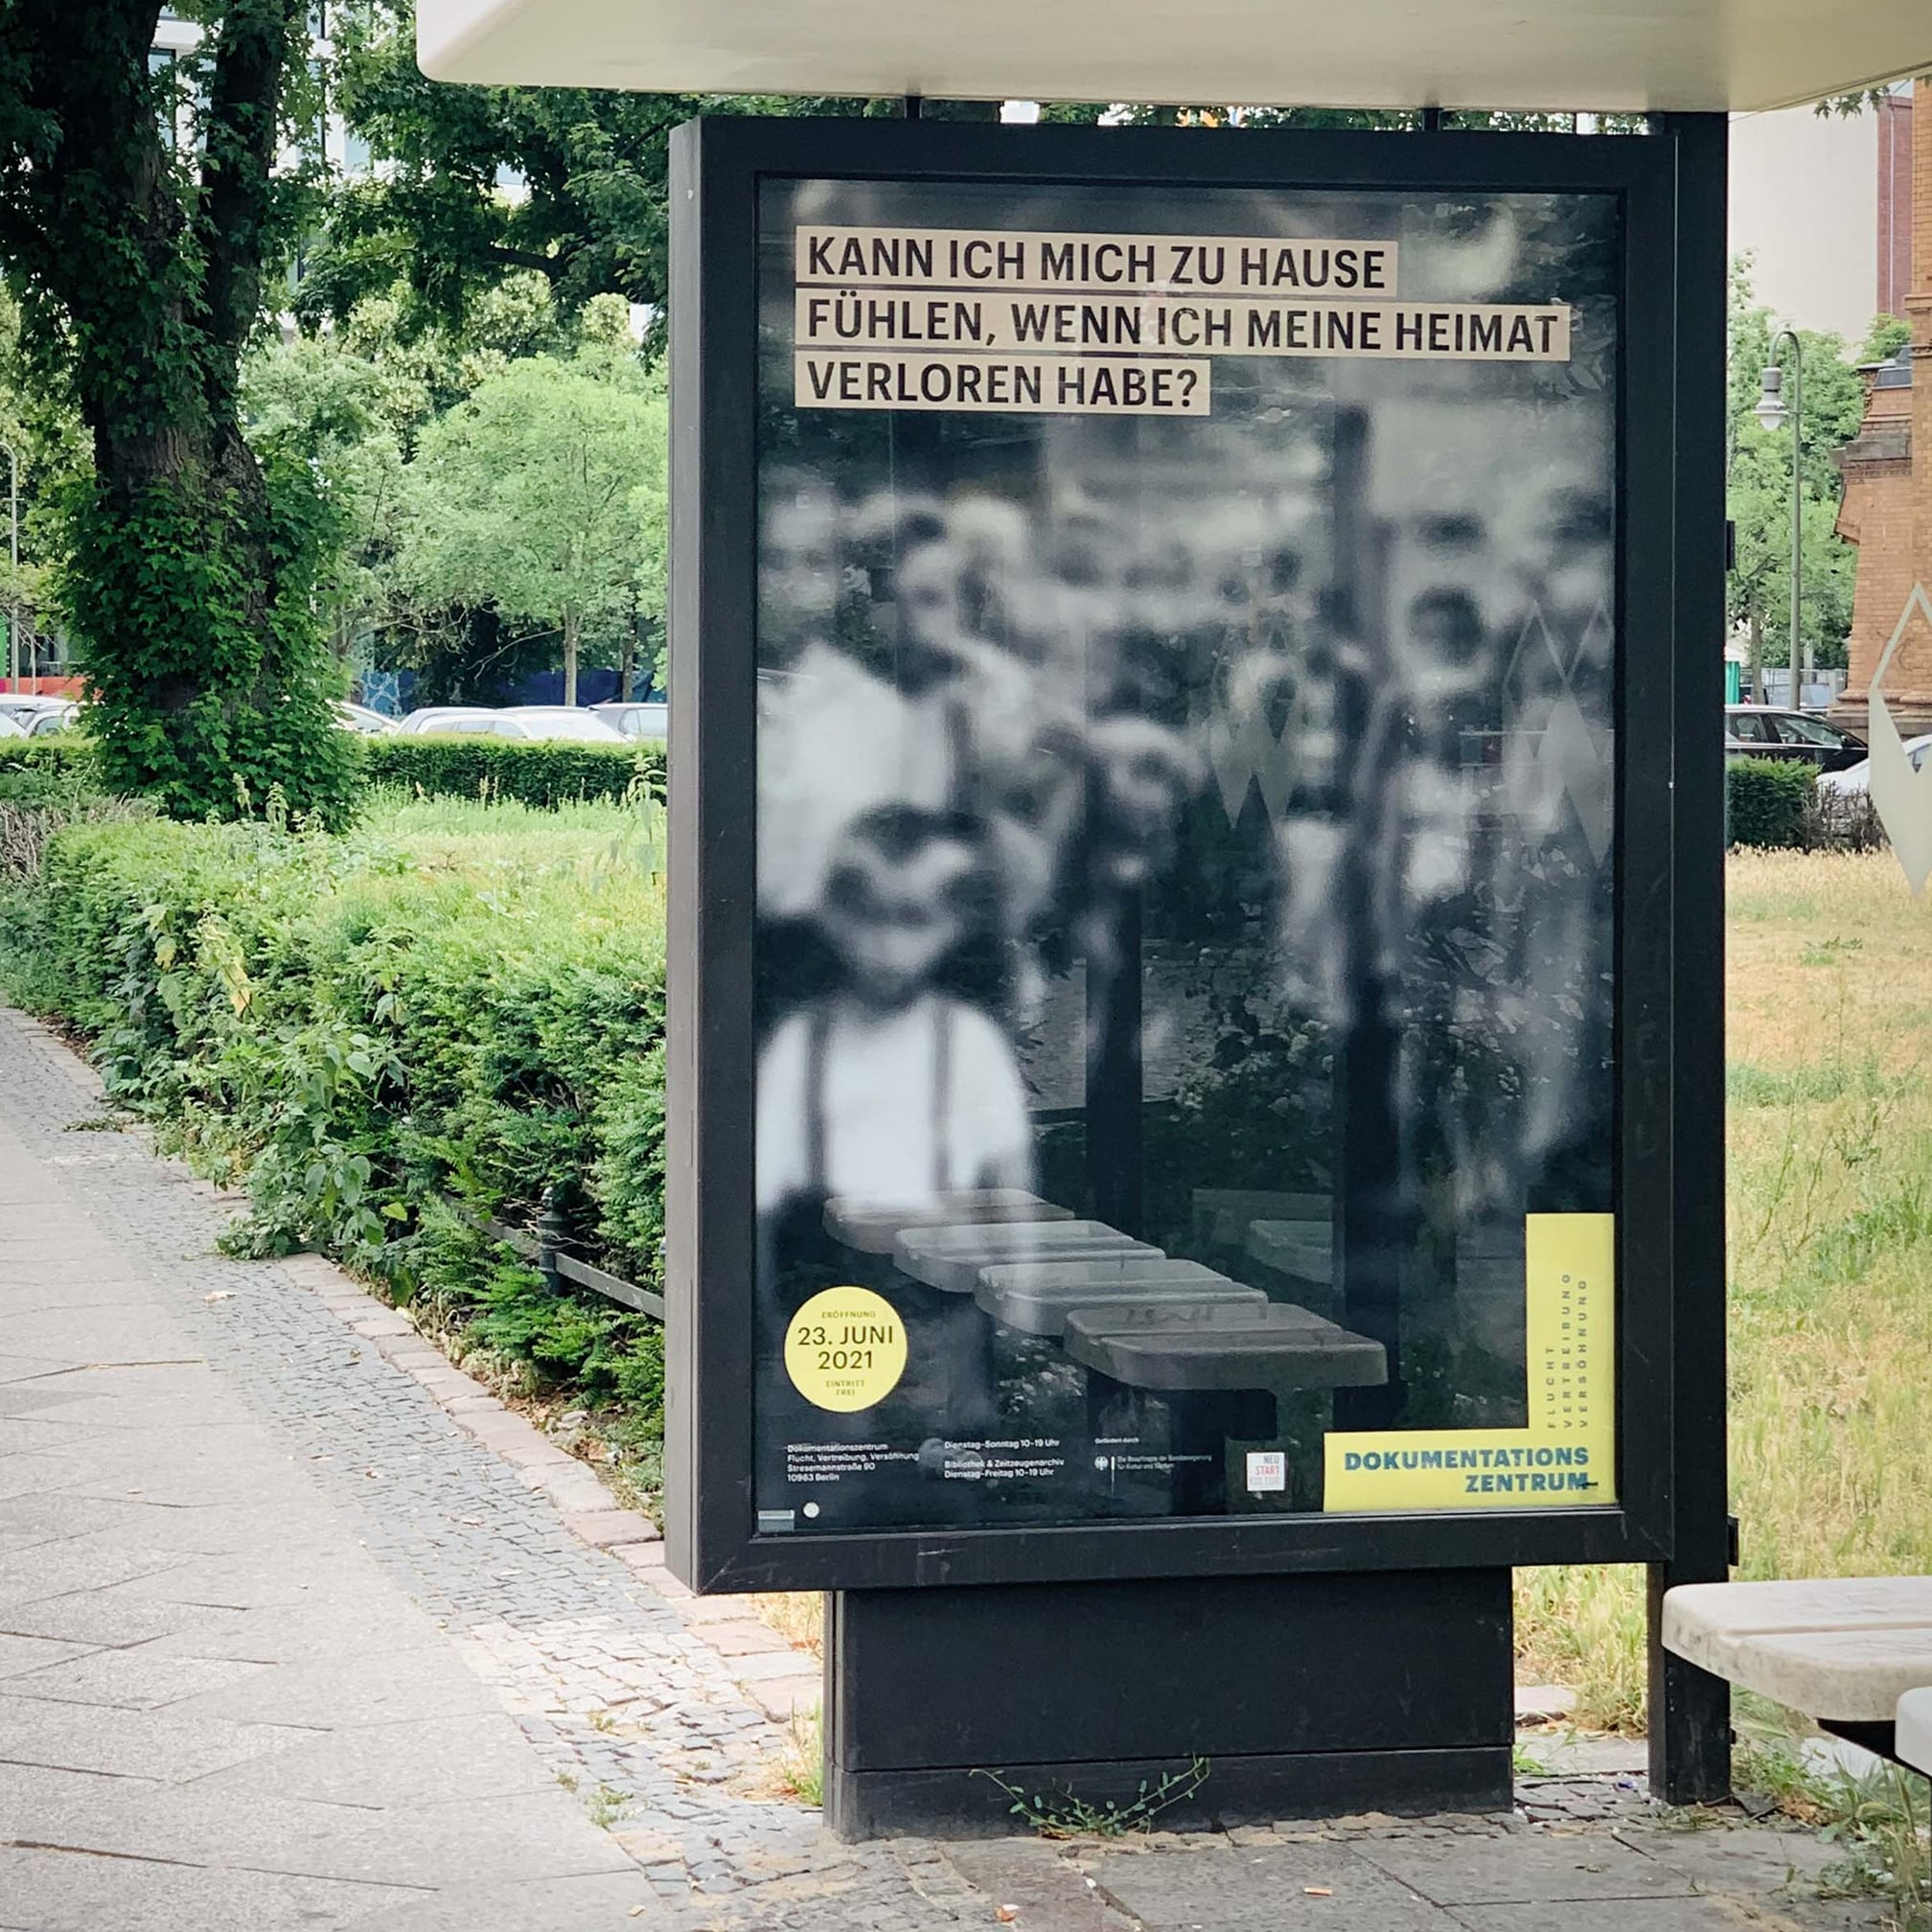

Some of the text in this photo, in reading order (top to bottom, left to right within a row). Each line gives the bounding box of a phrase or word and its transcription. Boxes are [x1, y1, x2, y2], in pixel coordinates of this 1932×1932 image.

[808, 236, 1387, 289] KANN ICH MICH ZU HAUSE
[808, 291, 1558, 355] FÜHLEN, WENN ICH MEINE HEIMAT
[807, 360, 1199, 408] VERLOREN HABE?
[821, 1310, 876, 1320] ERÖFFNUNG
[797, 1325, 893, 1346] 23. JUNI
[817, 1350, 873, 1370] 2021
[825, 1379, 865, 1389] EINTRITT
[1545, 1346, 1557, 1429] FLUCHT
[787, 1444, 888, 1453] Dokumentationszentrum
[1045, 1438, 1060, 1447] Uhr
[944, 1460, 985, 1468] Bibliothek
[1344, 1446, 1590, 1472] DOKUMENTATIONS
[788, 1463, 862, 1472] Stresemannstraße
[1039, 1467, 1054, 1476] Uhr
[1255, 1465, 1279, 1476] START
[1464, 1471, 1589, 1493] ZENTRUM
